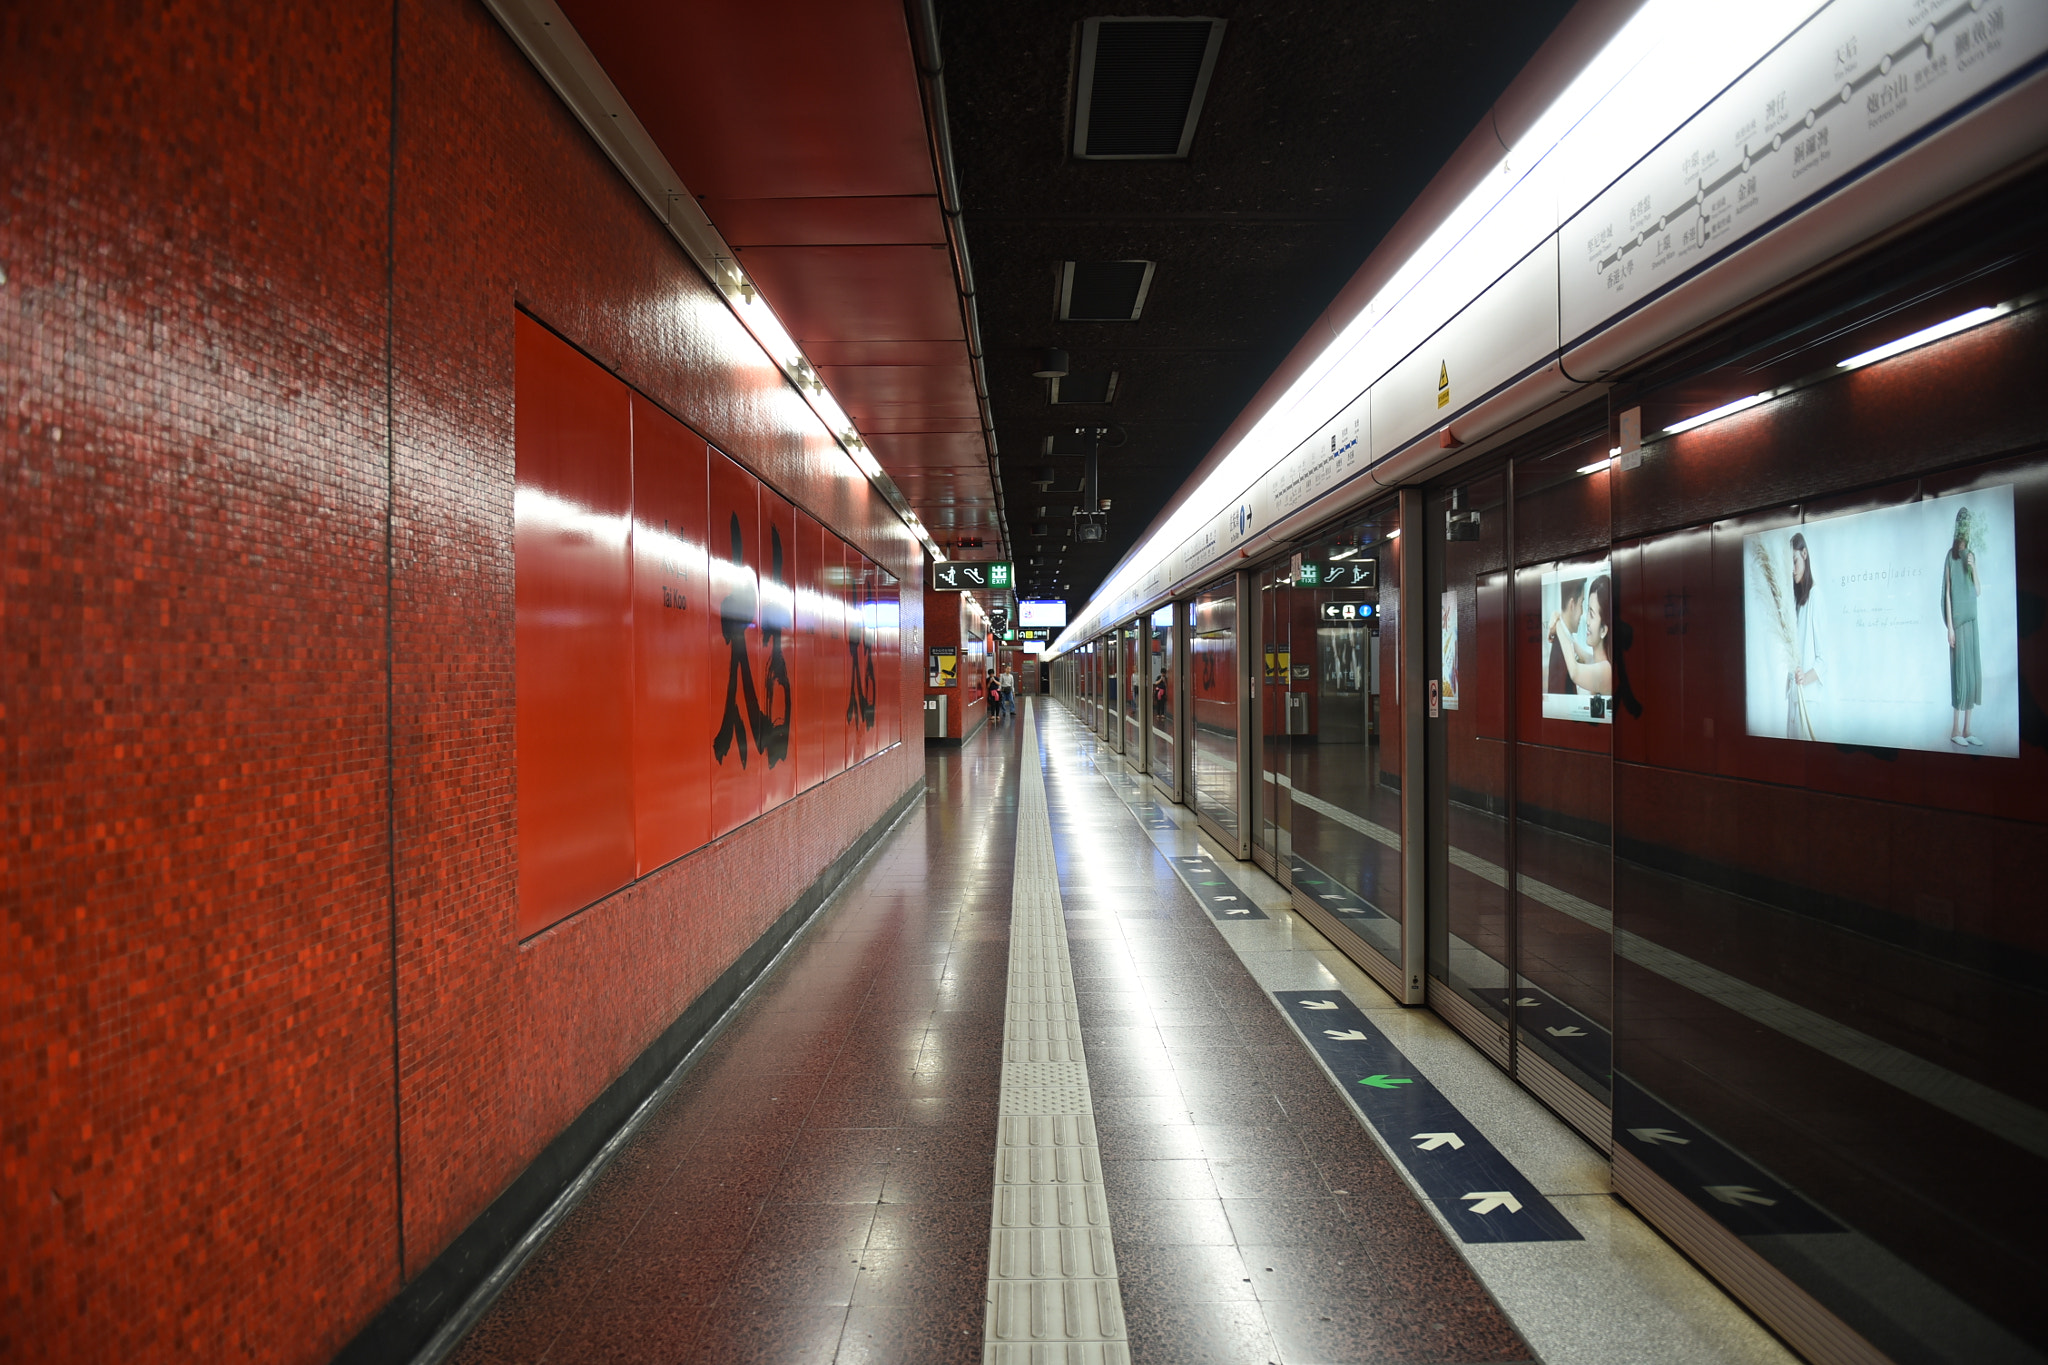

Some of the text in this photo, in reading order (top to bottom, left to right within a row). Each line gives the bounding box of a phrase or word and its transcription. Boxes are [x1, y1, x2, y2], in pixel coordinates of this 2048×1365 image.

[991, 566, 1008, 579] 出
[662, 585, 687, 610] Tai Koo
